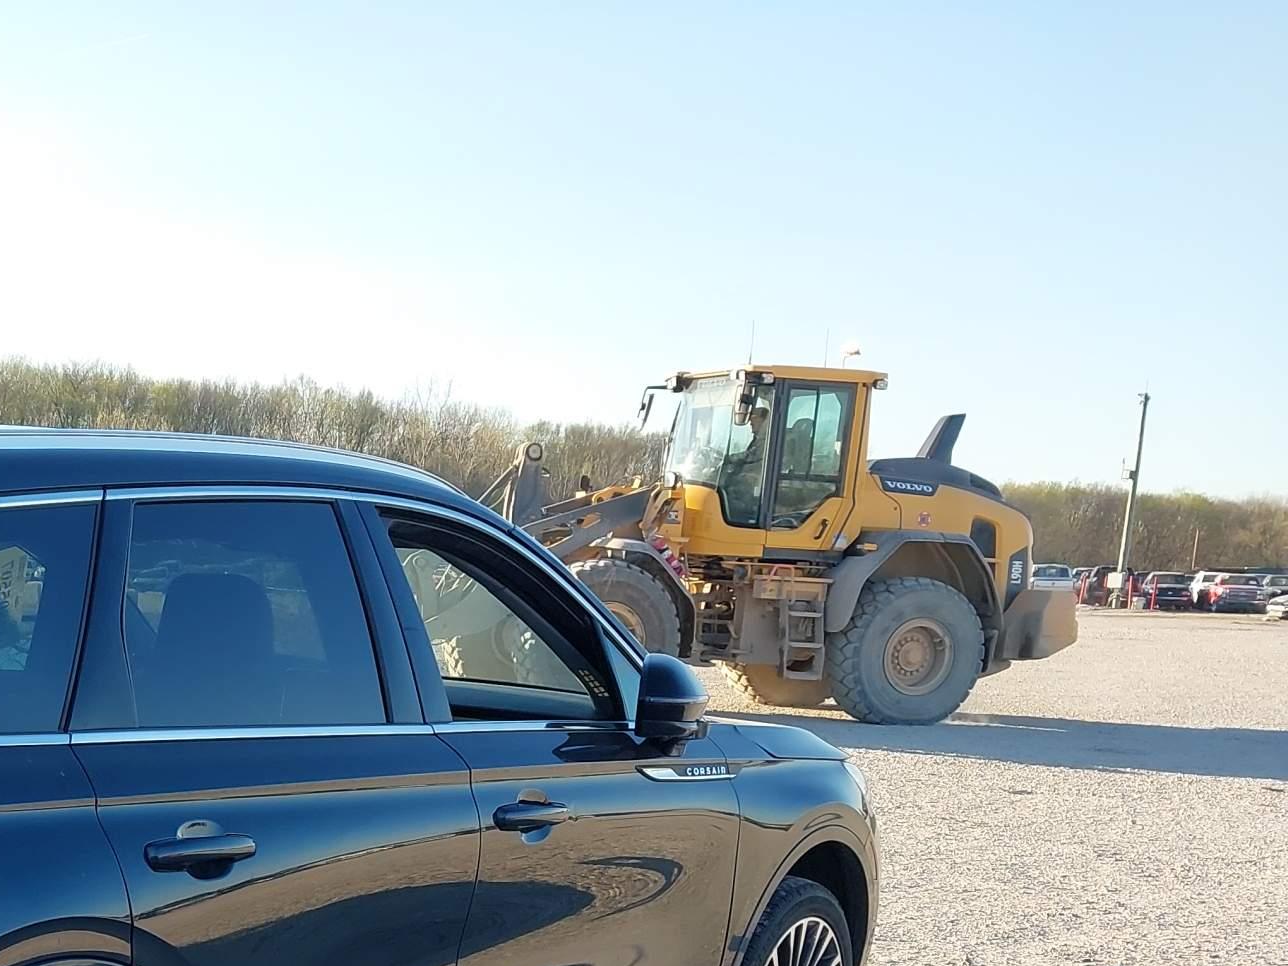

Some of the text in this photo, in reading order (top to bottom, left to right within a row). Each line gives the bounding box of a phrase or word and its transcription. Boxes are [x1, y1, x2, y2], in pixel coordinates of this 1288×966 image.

[884, 480, 933, 493] VOLVO
[1010, 560, 1023, 584] L90H
[686, 765, 726, 776] CORSAIR
